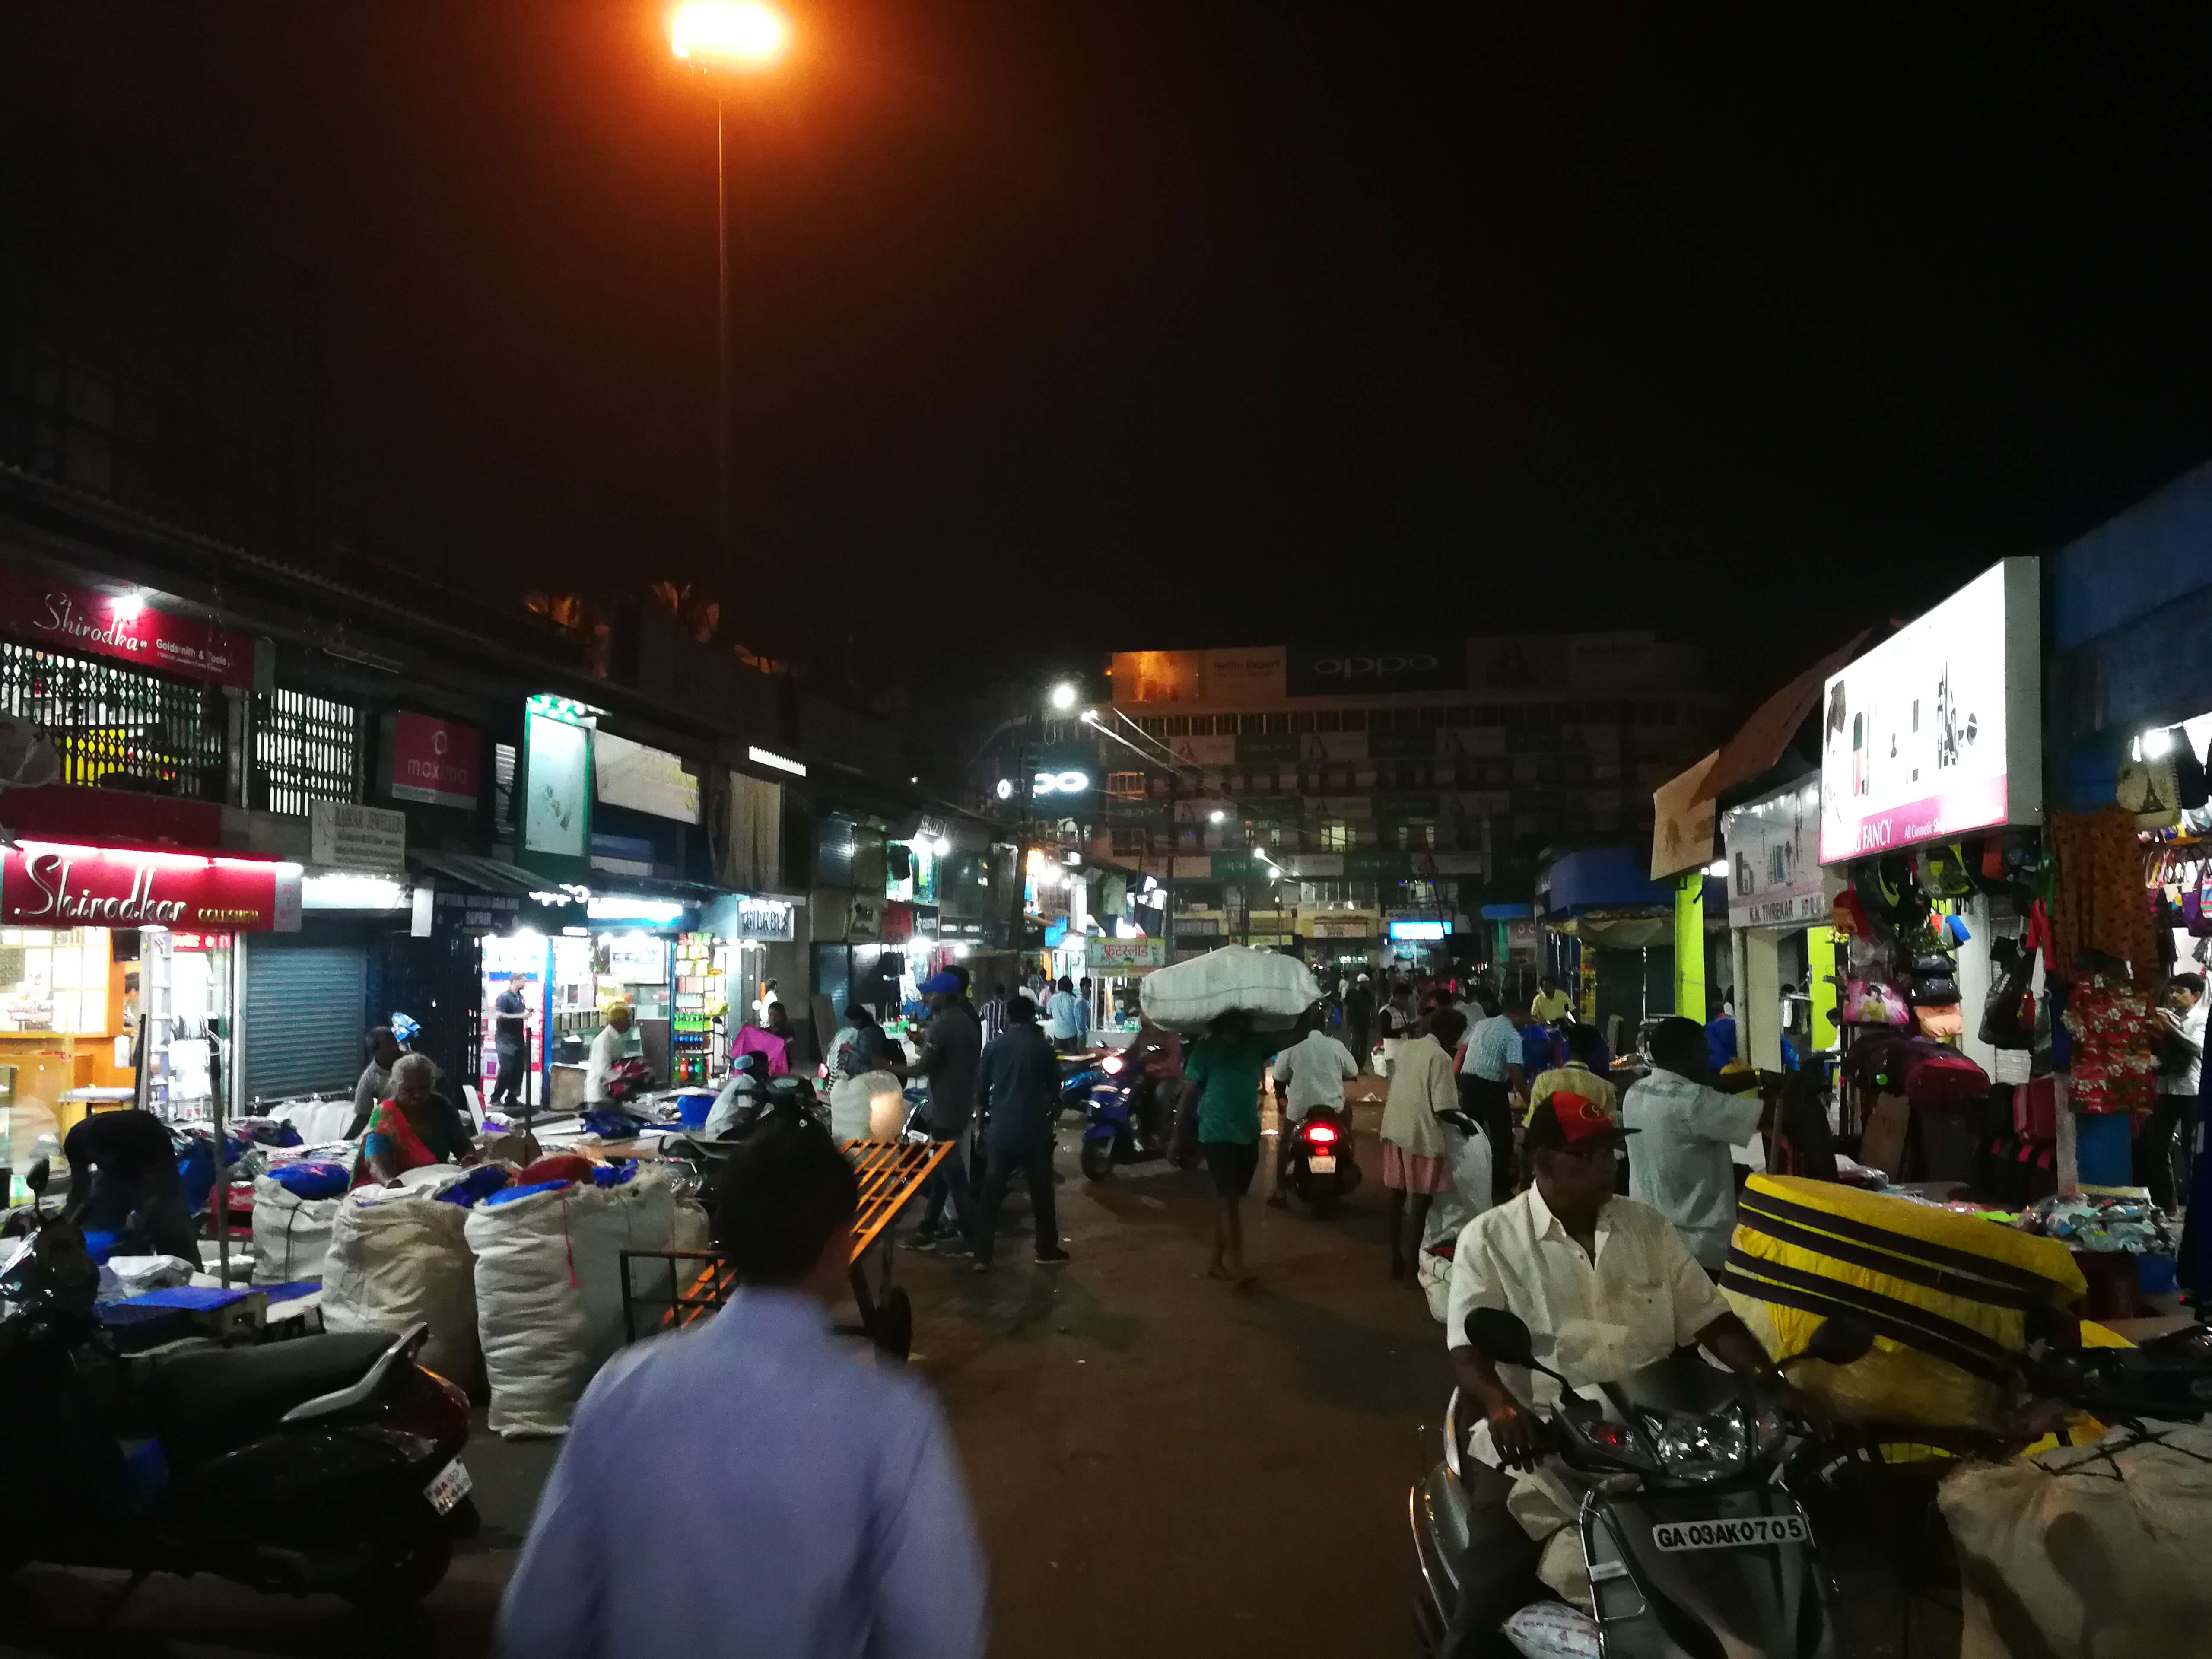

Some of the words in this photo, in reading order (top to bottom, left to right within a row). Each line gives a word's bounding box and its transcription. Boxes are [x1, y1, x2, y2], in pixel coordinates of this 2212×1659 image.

[1863, 818, 1893, 850] FANCY
[14, 853, 187, 923] Shirodkar
[198, 908, 259, 923] GOLDSMITH
